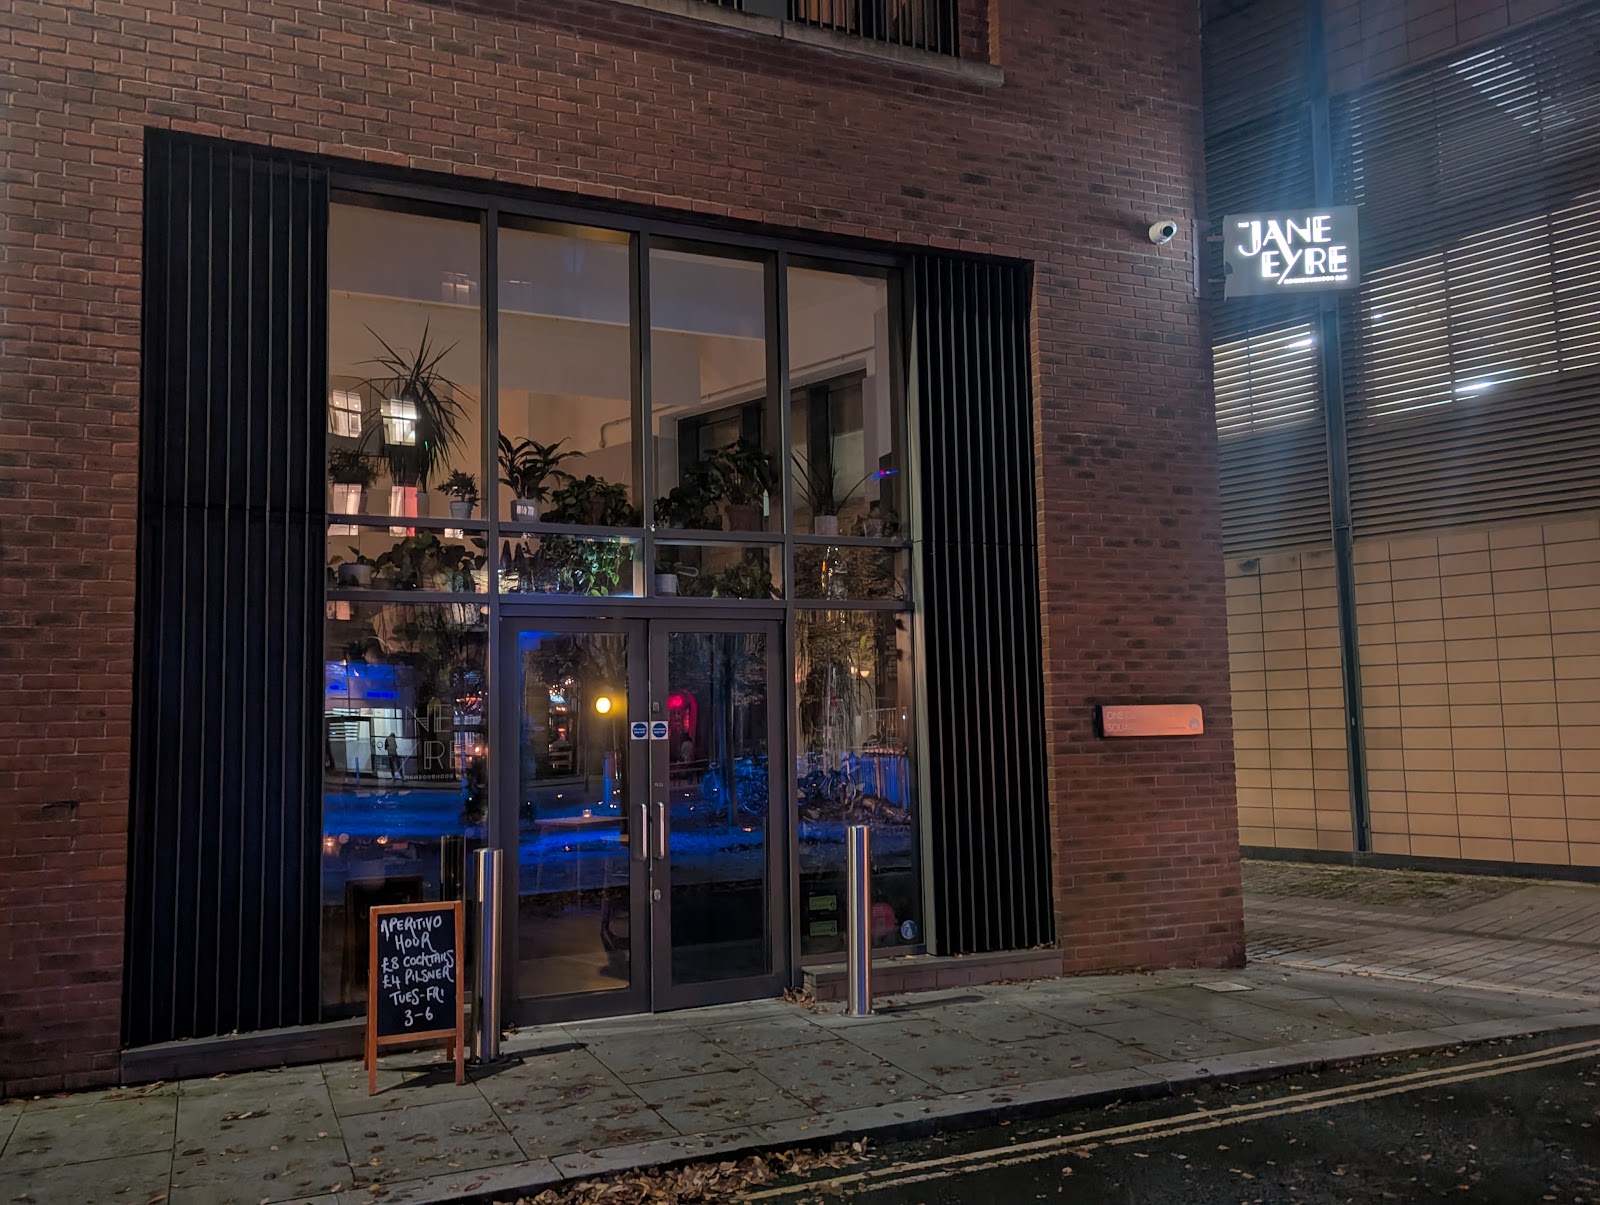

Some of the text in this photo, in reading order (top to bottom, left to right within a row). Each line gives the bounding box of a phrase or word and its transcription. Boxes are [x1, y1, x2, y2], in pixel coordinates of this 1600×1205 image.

[1237, 215, 1332, 257] JANE
[1261, 245, 1348, 285] EYRE
[381, 915, 442, 941] APERITIVO
[395, 931, 437, 954] HOUR
[381, 949, 454, 974] £8 COCKTAILS
[382, 966, 455, 990] £4 PILSNER
